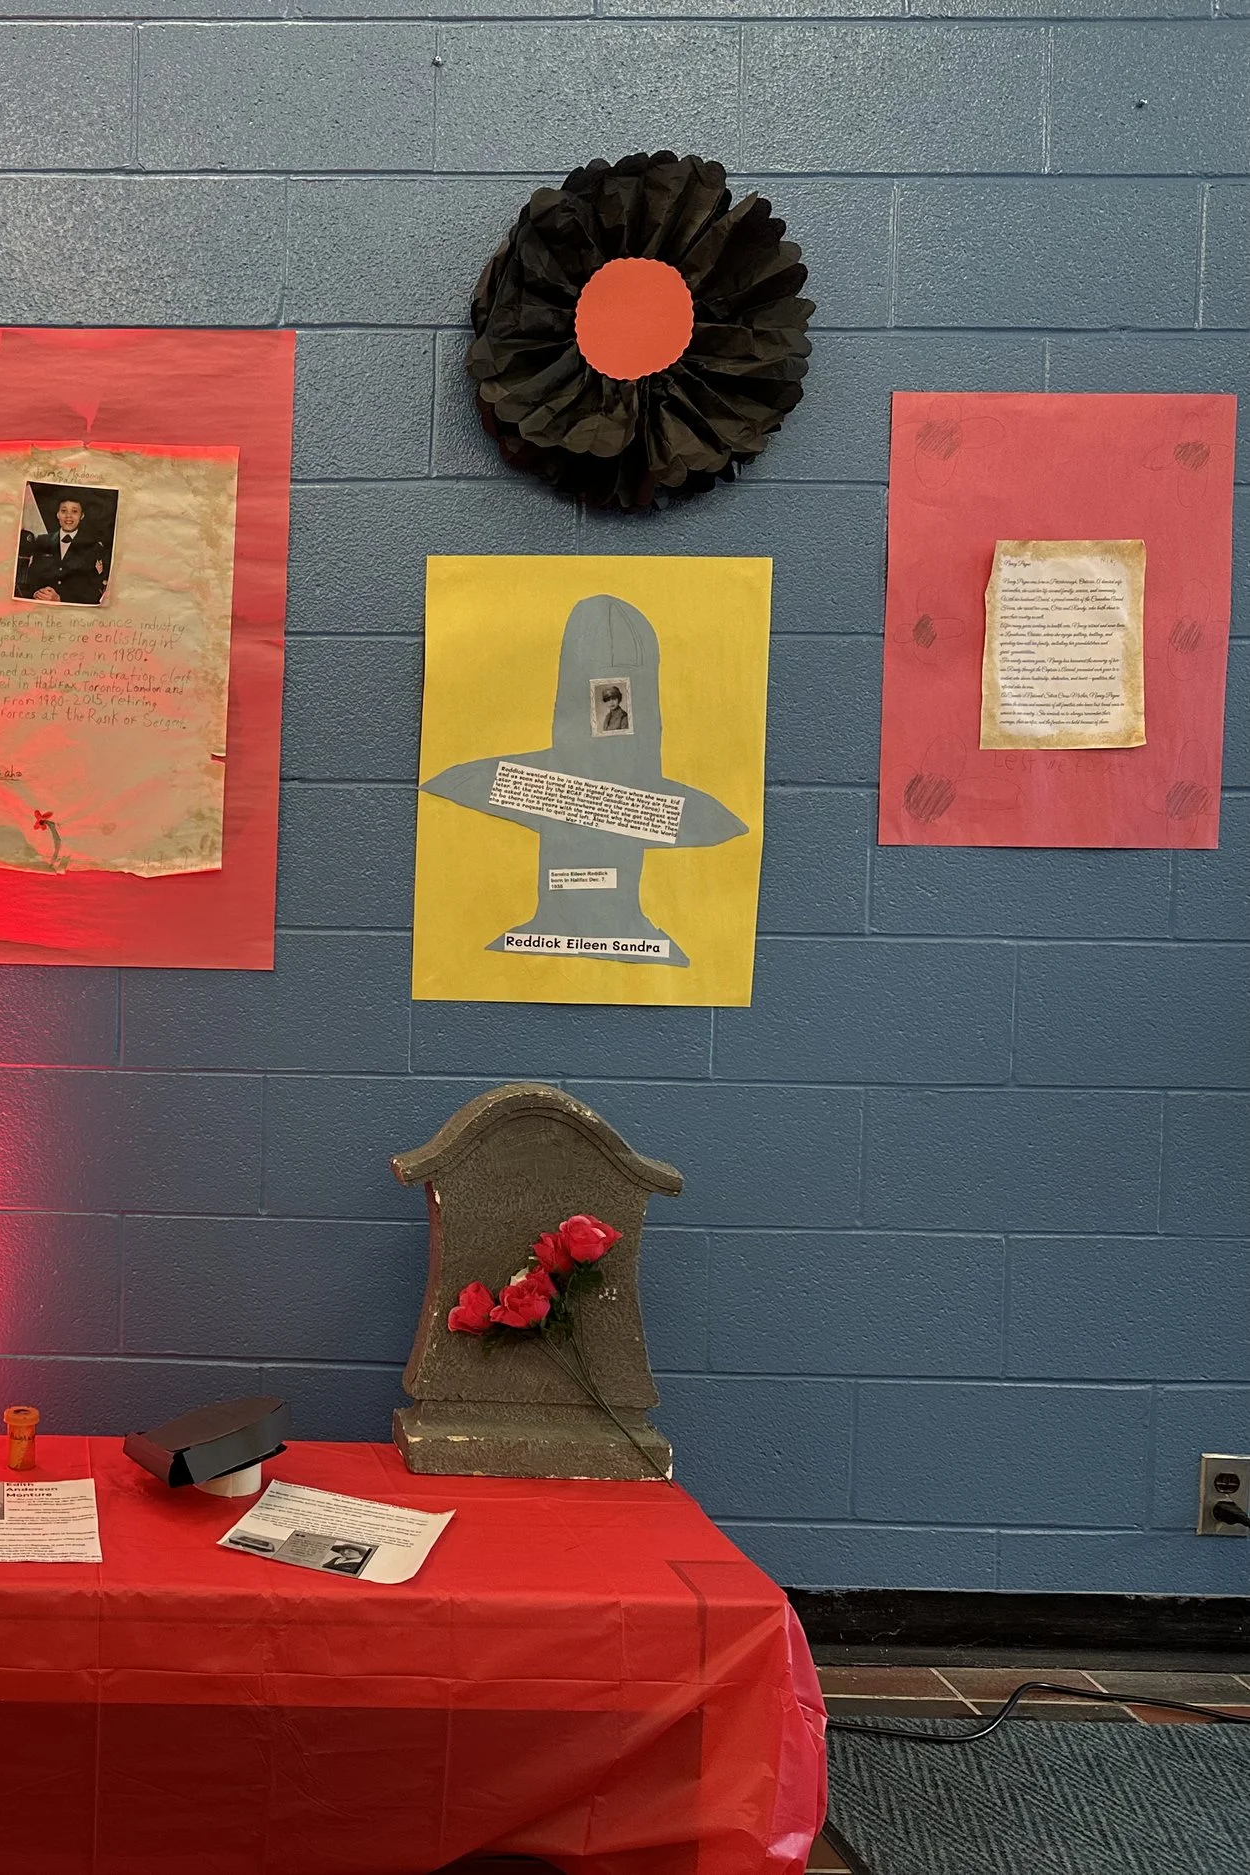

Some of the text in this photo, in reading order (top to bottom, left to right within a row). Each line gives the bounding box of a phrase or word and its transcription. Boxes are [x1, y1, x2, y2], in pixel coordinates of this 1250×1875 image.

[34, 617, 43, 628] in
[45, 614, 63, 628] the
[70, 614, 132, 629] insurance
[140, 614, 186, 641] industry
[94, 650, 106, 661] in
[21, 668, 37, 677] as
[41, 667, 57, 675] an
[19, 678, 29, 689] in
[126, 680, 162, 693] London
[42, 707, 58, 720] at
[67, 707, 85, 720] the
[502, 766, 524, 774] Reddick
[584, 782, 599, 790] Navy
[610, 787, 628, 795] Force
[522, 803, 545, 811] request
[602, 796, 630, 806] Canadian
[636, 798, 651, 806] Navy
[506, 936, 660, 953] Reddick Eileen Sandra
